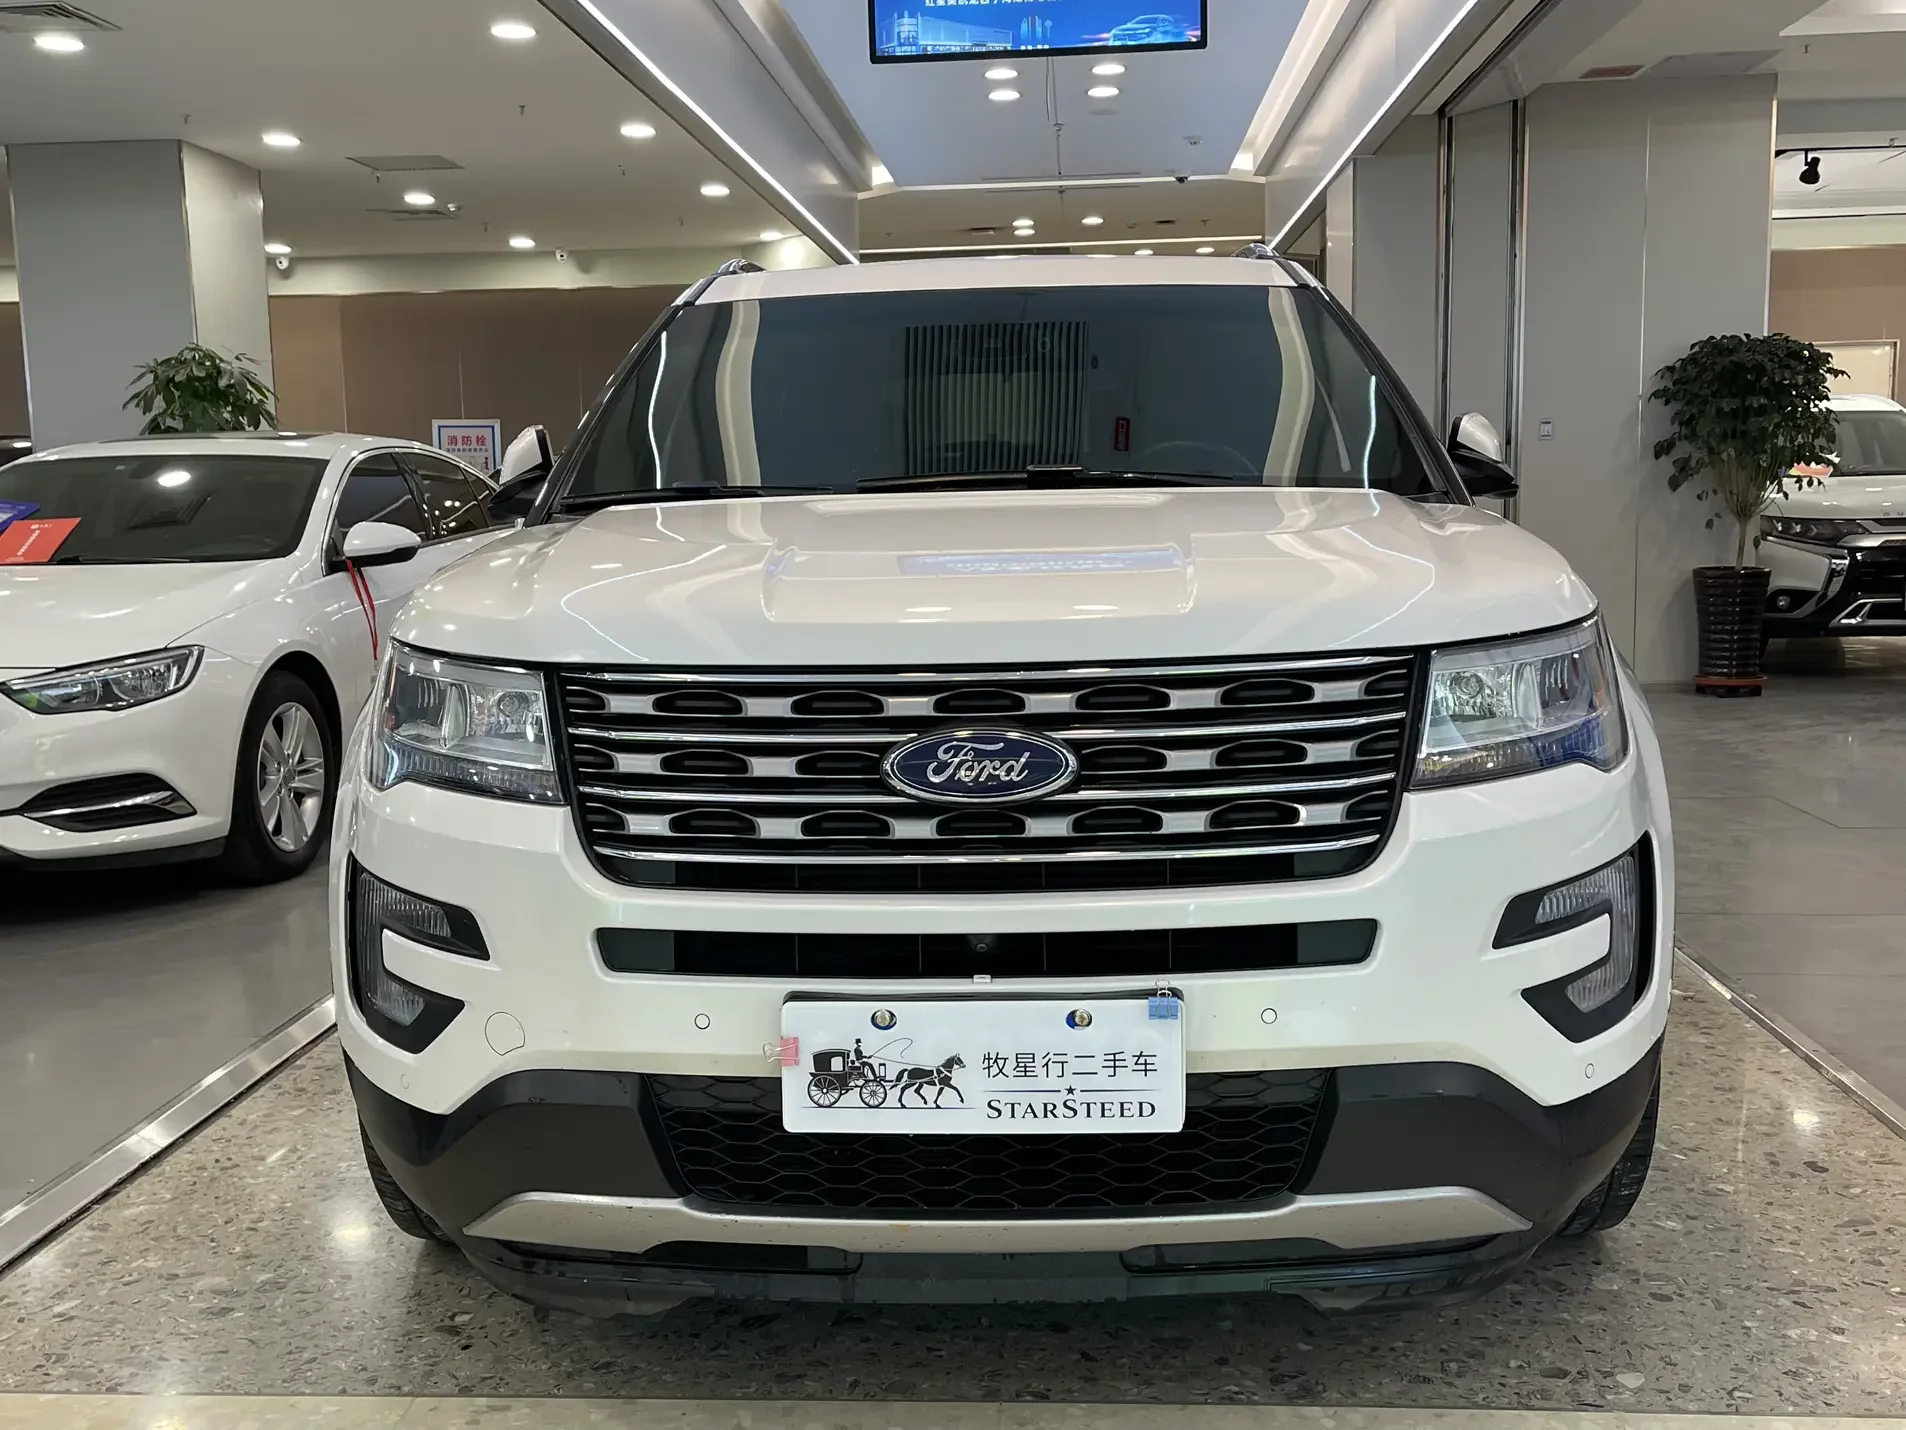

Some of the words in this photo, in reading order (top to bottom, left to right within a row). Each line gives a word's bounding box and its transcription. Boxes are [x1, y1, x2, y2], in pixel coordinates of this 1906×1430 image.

[447, 435, 487, 447] 消防栓
[926, 741, 1031, 783] Ford
[981, 1050, 1159, 1079] 牧星行二手车
